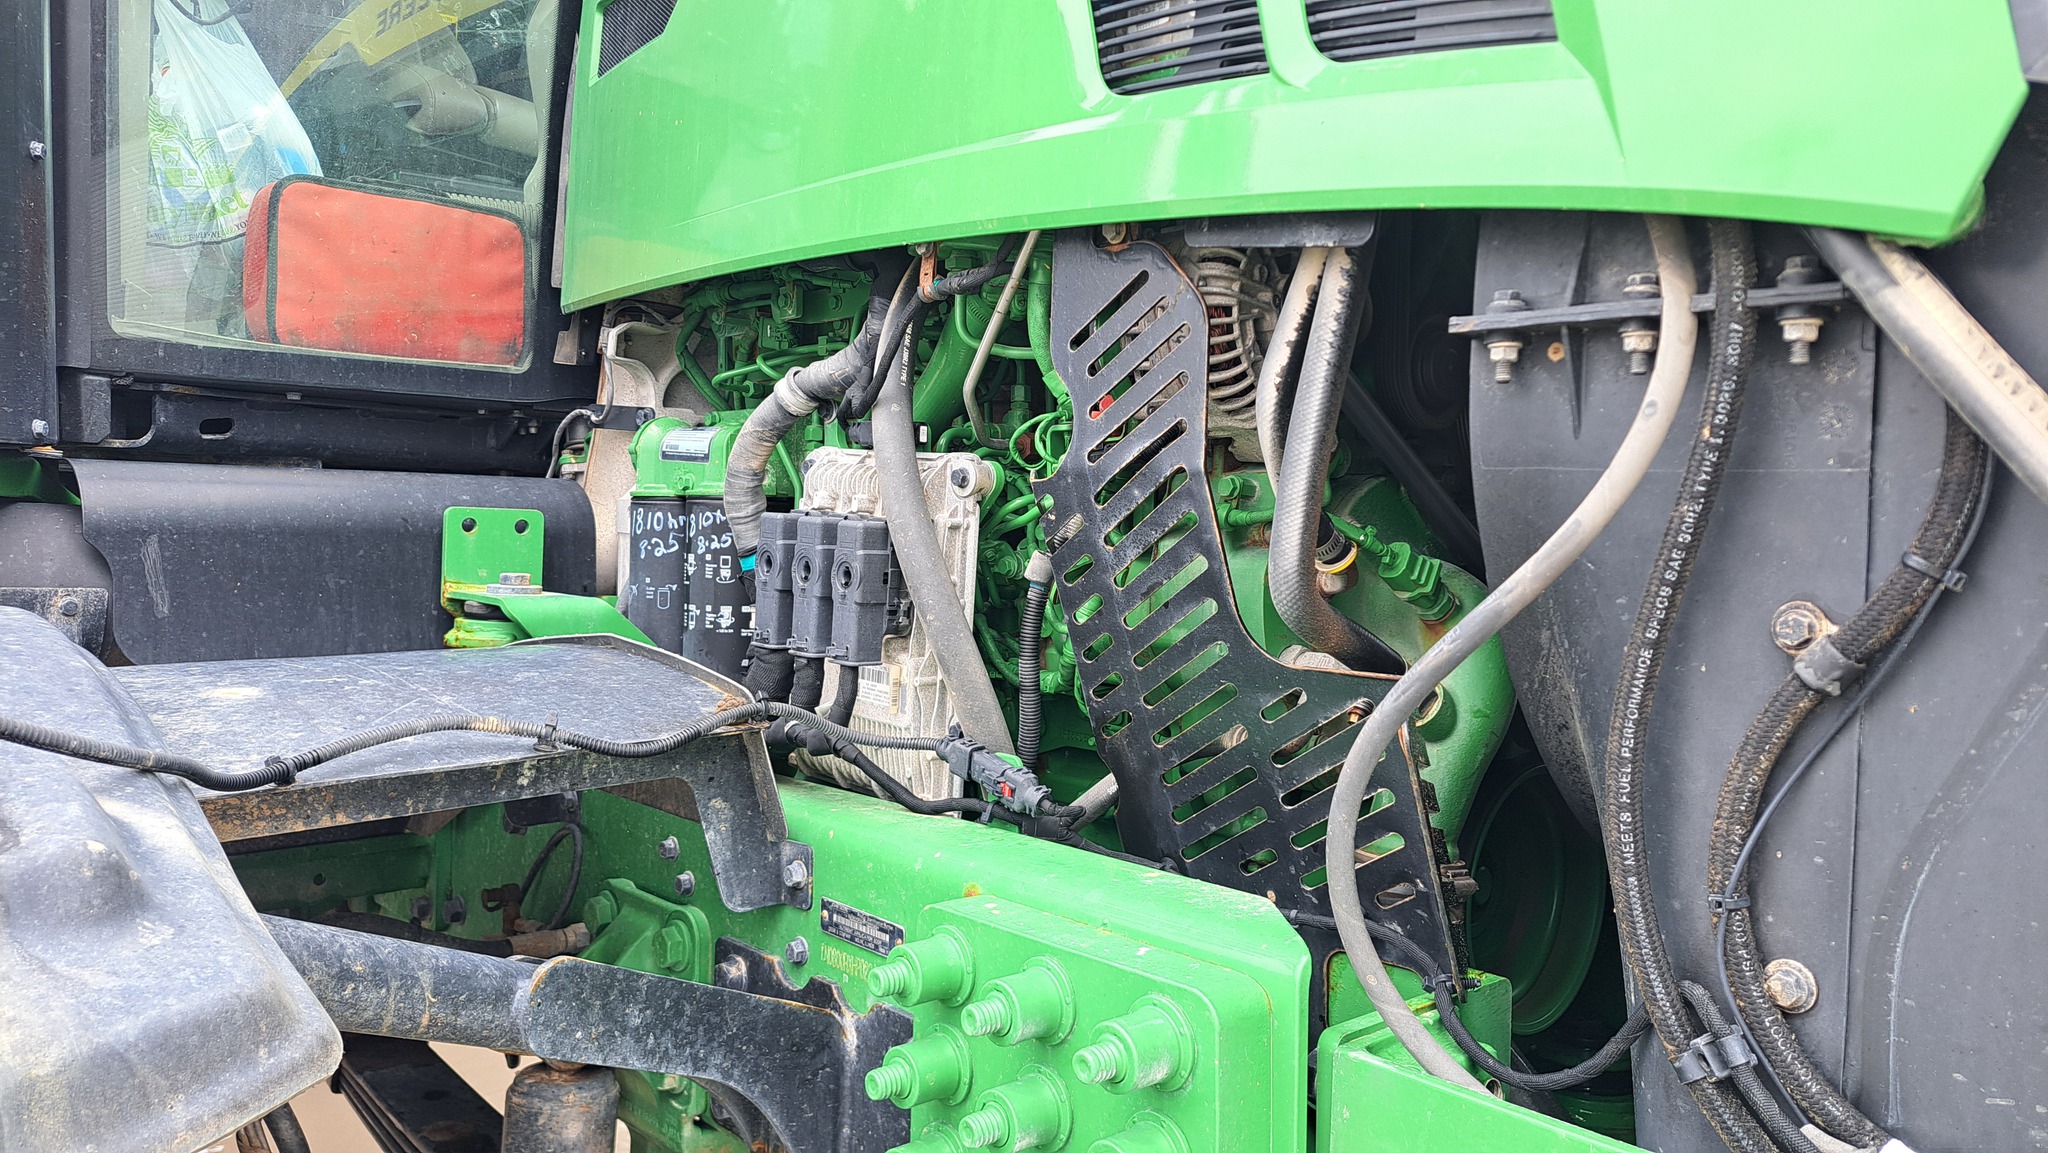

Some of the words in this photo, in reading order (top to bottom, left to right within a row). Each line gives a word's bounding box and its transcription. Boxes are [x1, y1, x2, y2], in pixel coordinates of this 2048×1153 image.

[900, 365, 908, 383] TYPE
[1693, 450, 1719, 492] TYPE
[1664, 548, 1686, 581] SAE
[1645, 585, 1673, 639] SPECS
[1621, 647, 1654, 757] PERFORMANCE
[1618, 763, 1632, 803] FUEL
[1619, 812, 1636, 865] MEETS
